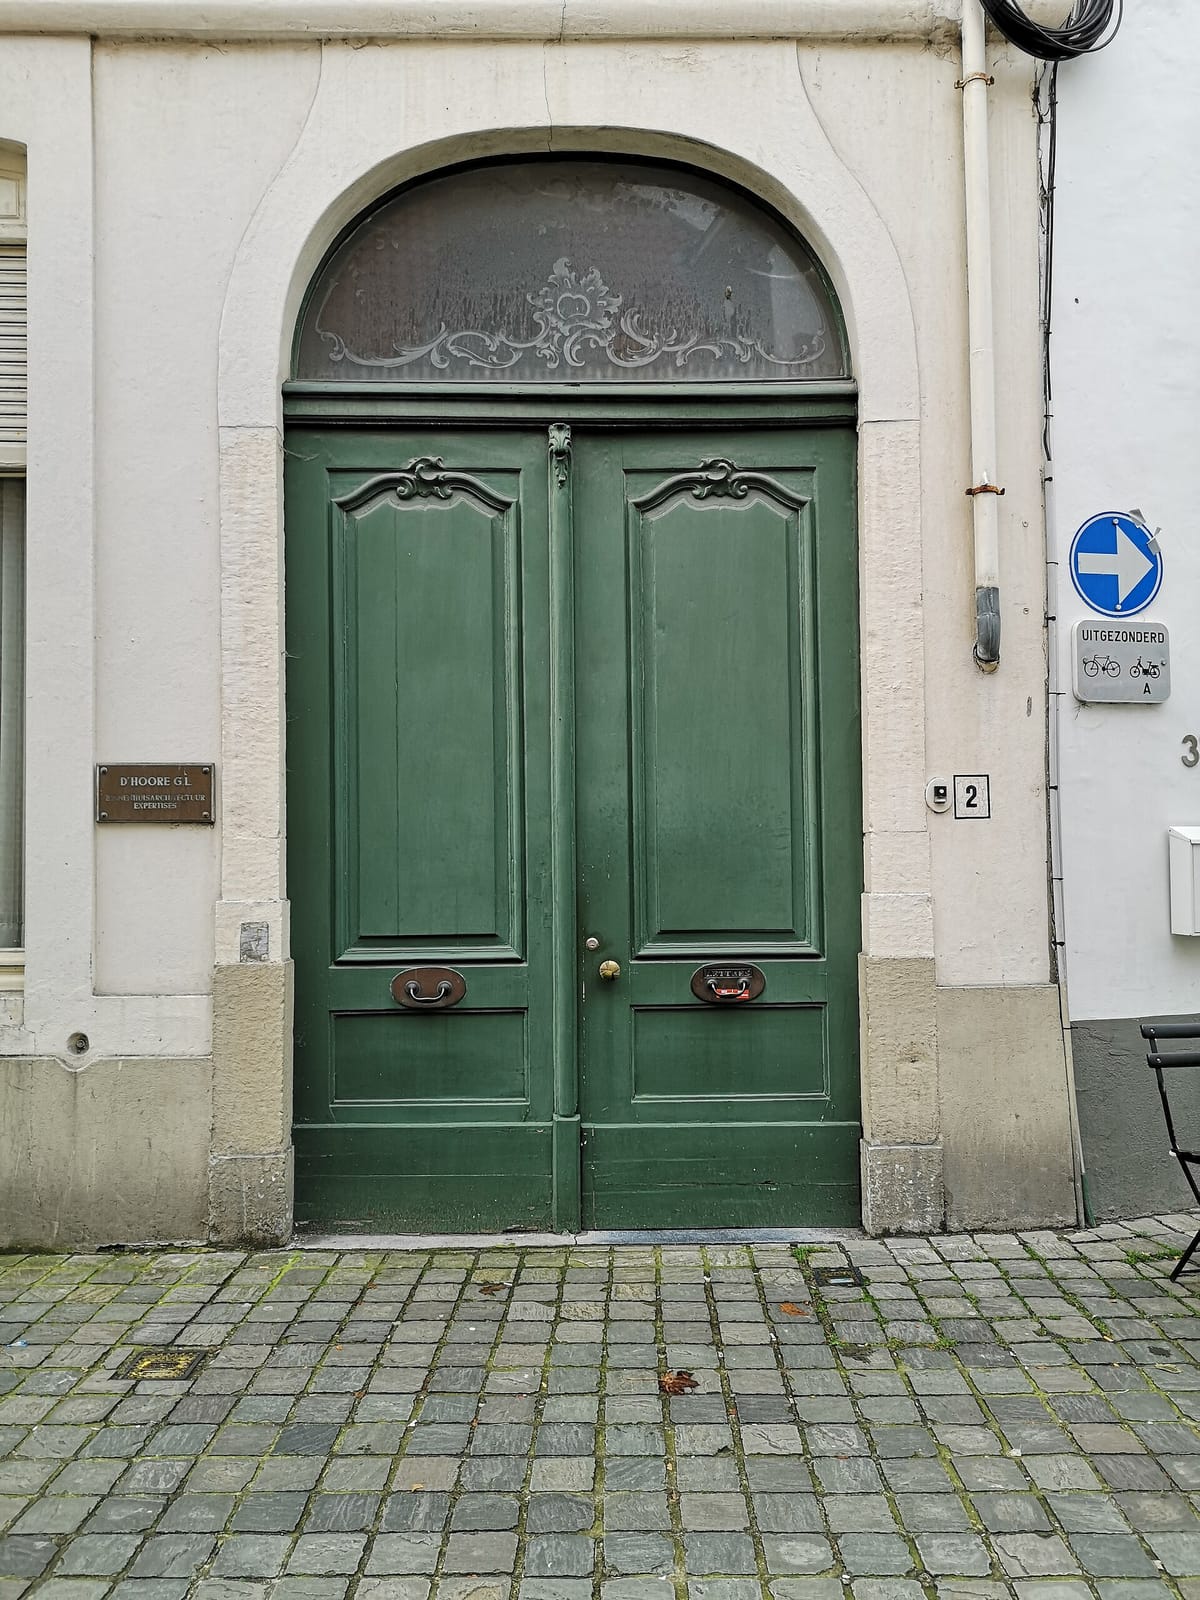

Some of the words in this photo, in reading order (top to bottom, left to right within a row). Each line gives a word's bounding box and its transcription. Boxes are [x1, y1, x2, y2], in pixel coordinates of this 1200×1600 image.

[1082, 629, 1165, 644] UITGEZONDERD
[1143, 682, 1151, 695] A
[120, 776, 171, 786] D'HOORE
[965, 784, 978, 808] 2
